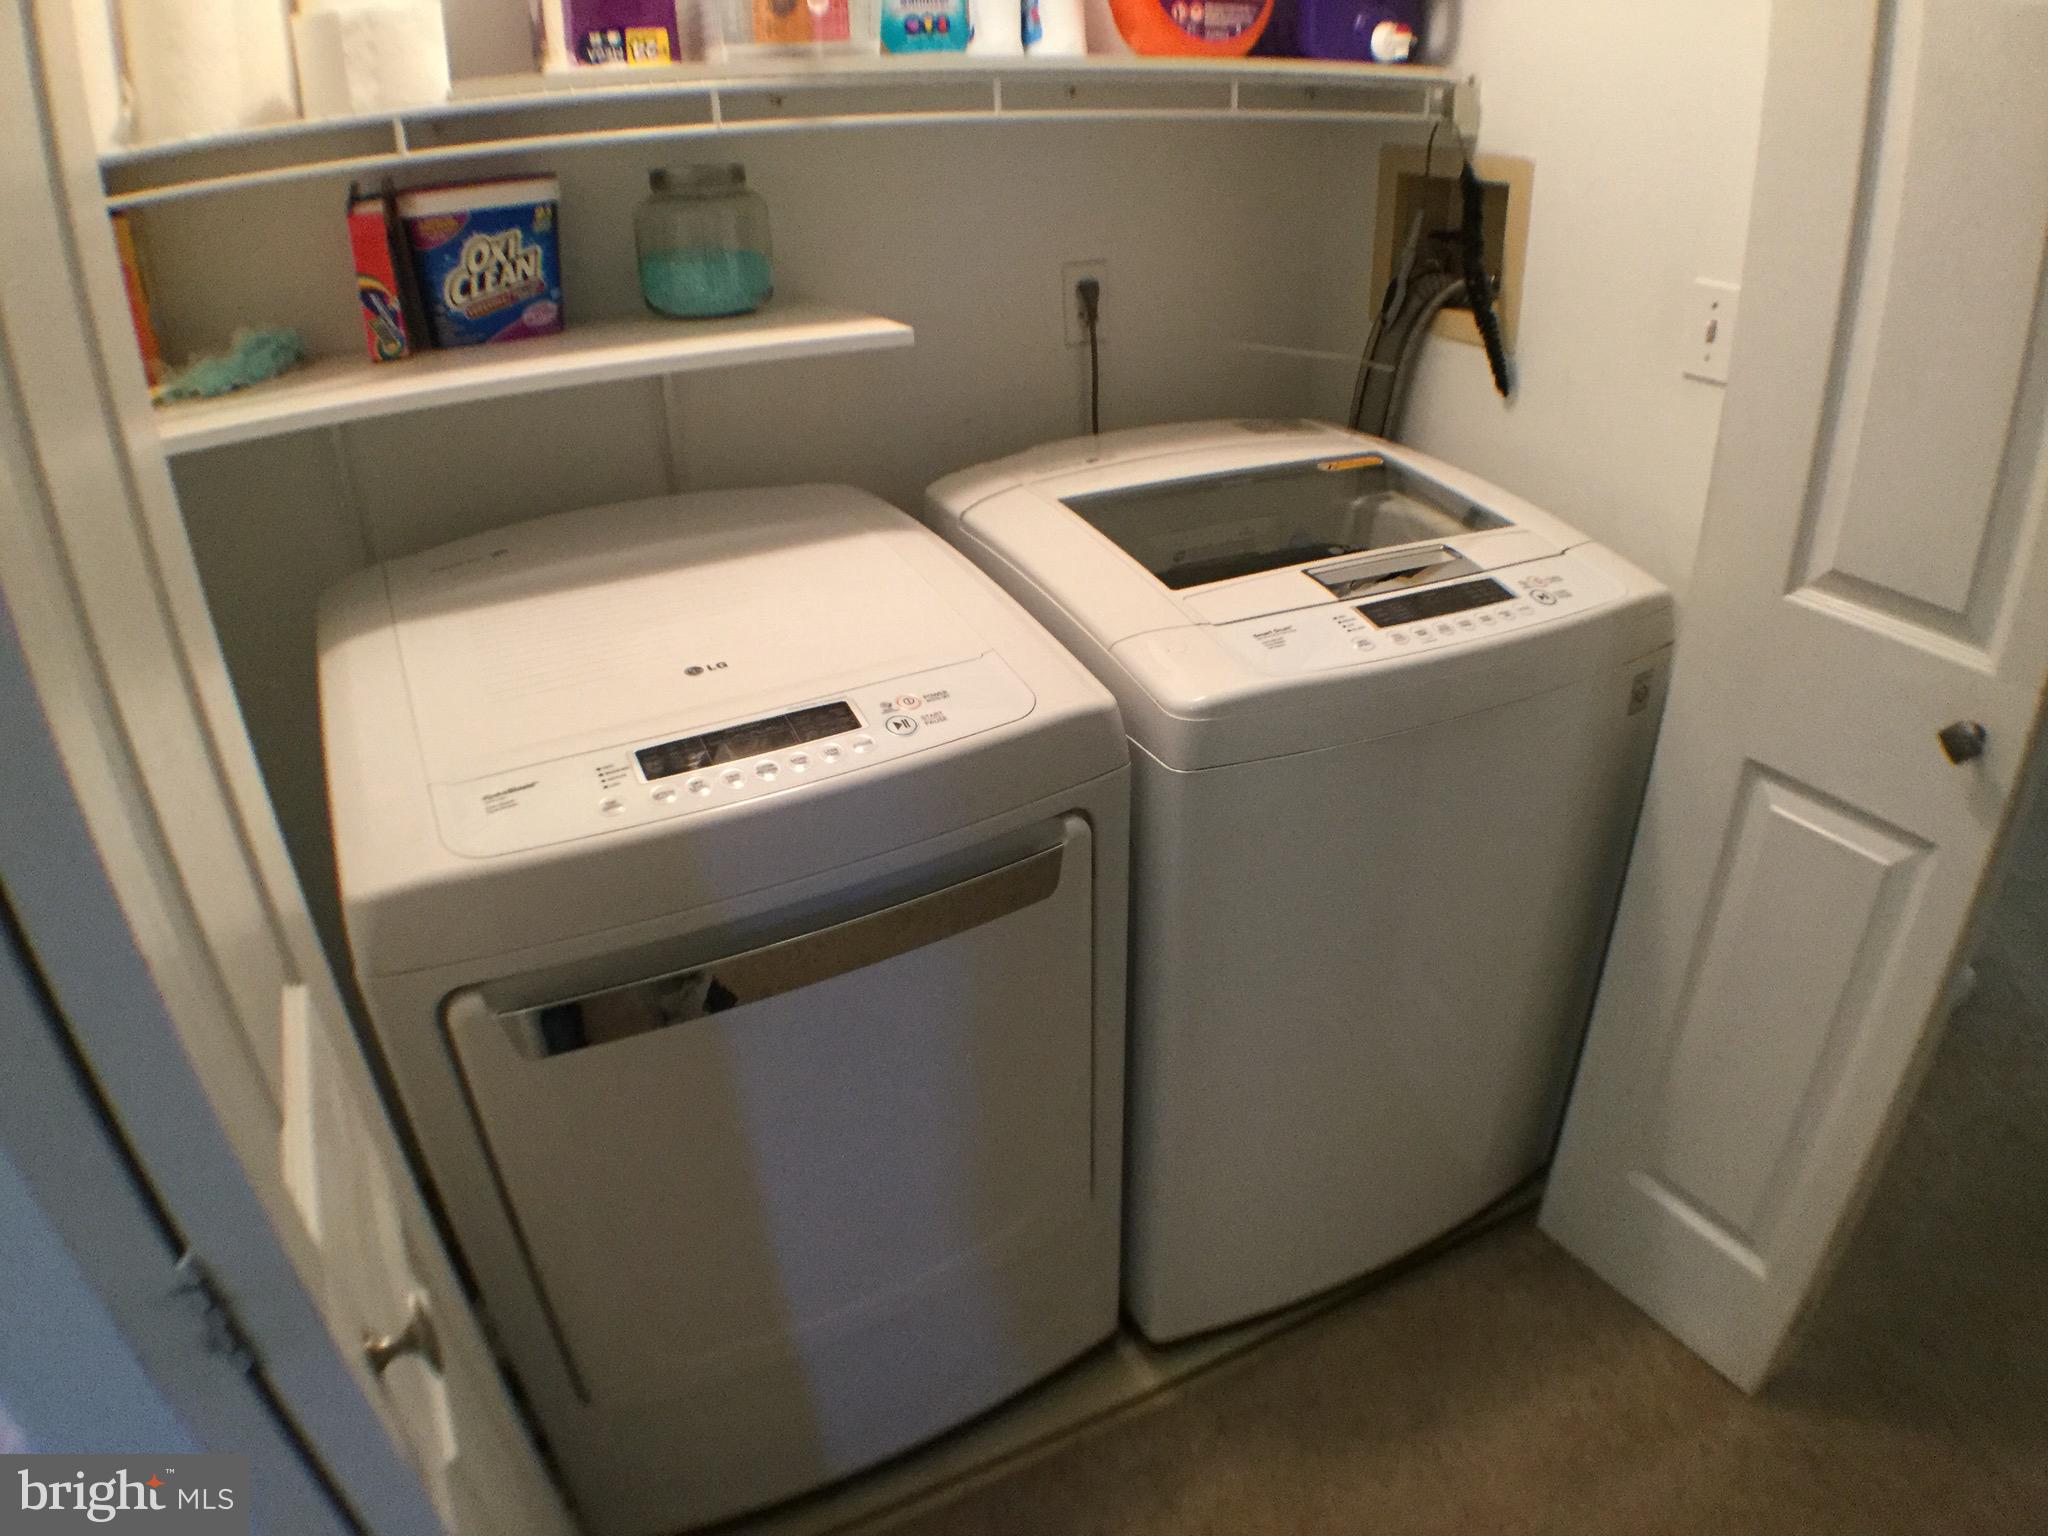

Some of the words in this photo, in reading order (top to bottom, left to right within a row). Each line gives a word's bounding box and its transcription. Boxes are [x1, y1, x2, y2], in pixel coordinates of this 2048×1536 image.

[463, 231, 518, 274] OXI
[449, 247, 540, 307] CLEAN
[706, 661, 729, 671] LG
